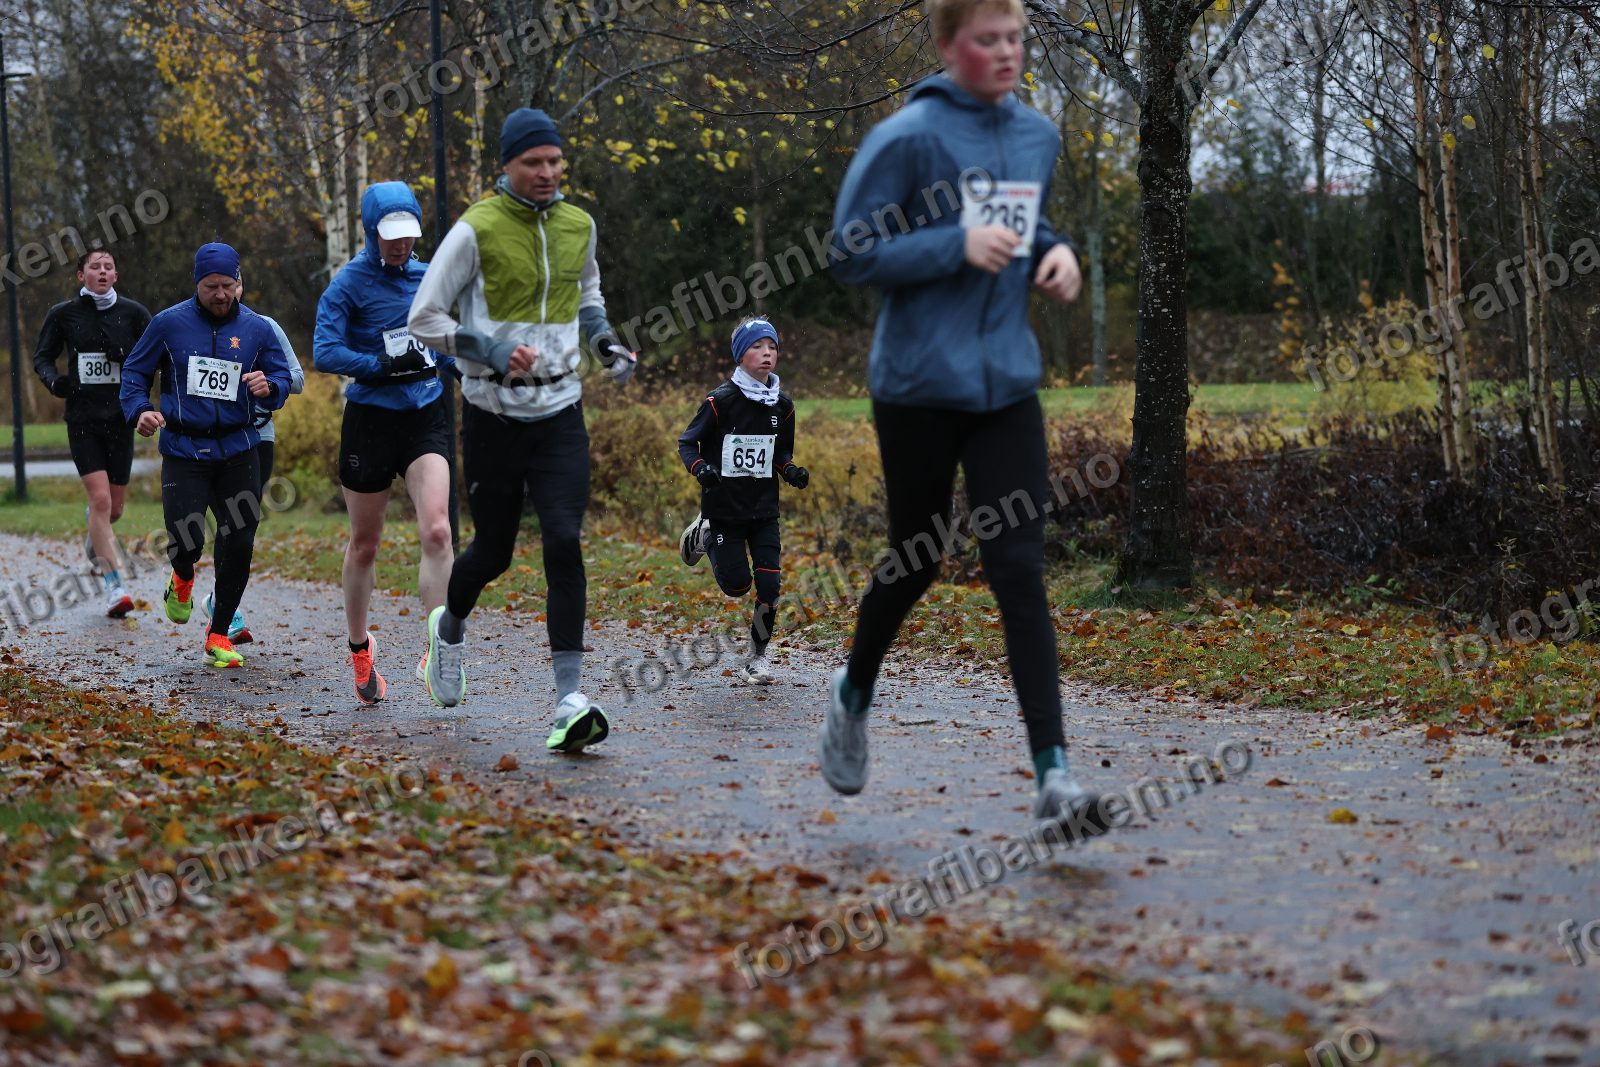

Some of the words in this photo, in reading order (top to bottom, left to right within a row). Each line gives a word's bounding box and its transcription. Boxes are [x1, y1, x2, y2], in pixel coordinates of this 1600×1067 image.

[85, 361, 112, 377] 380
[198, 368, 229, 392] 769
[733, 447, 766, 469] 654
